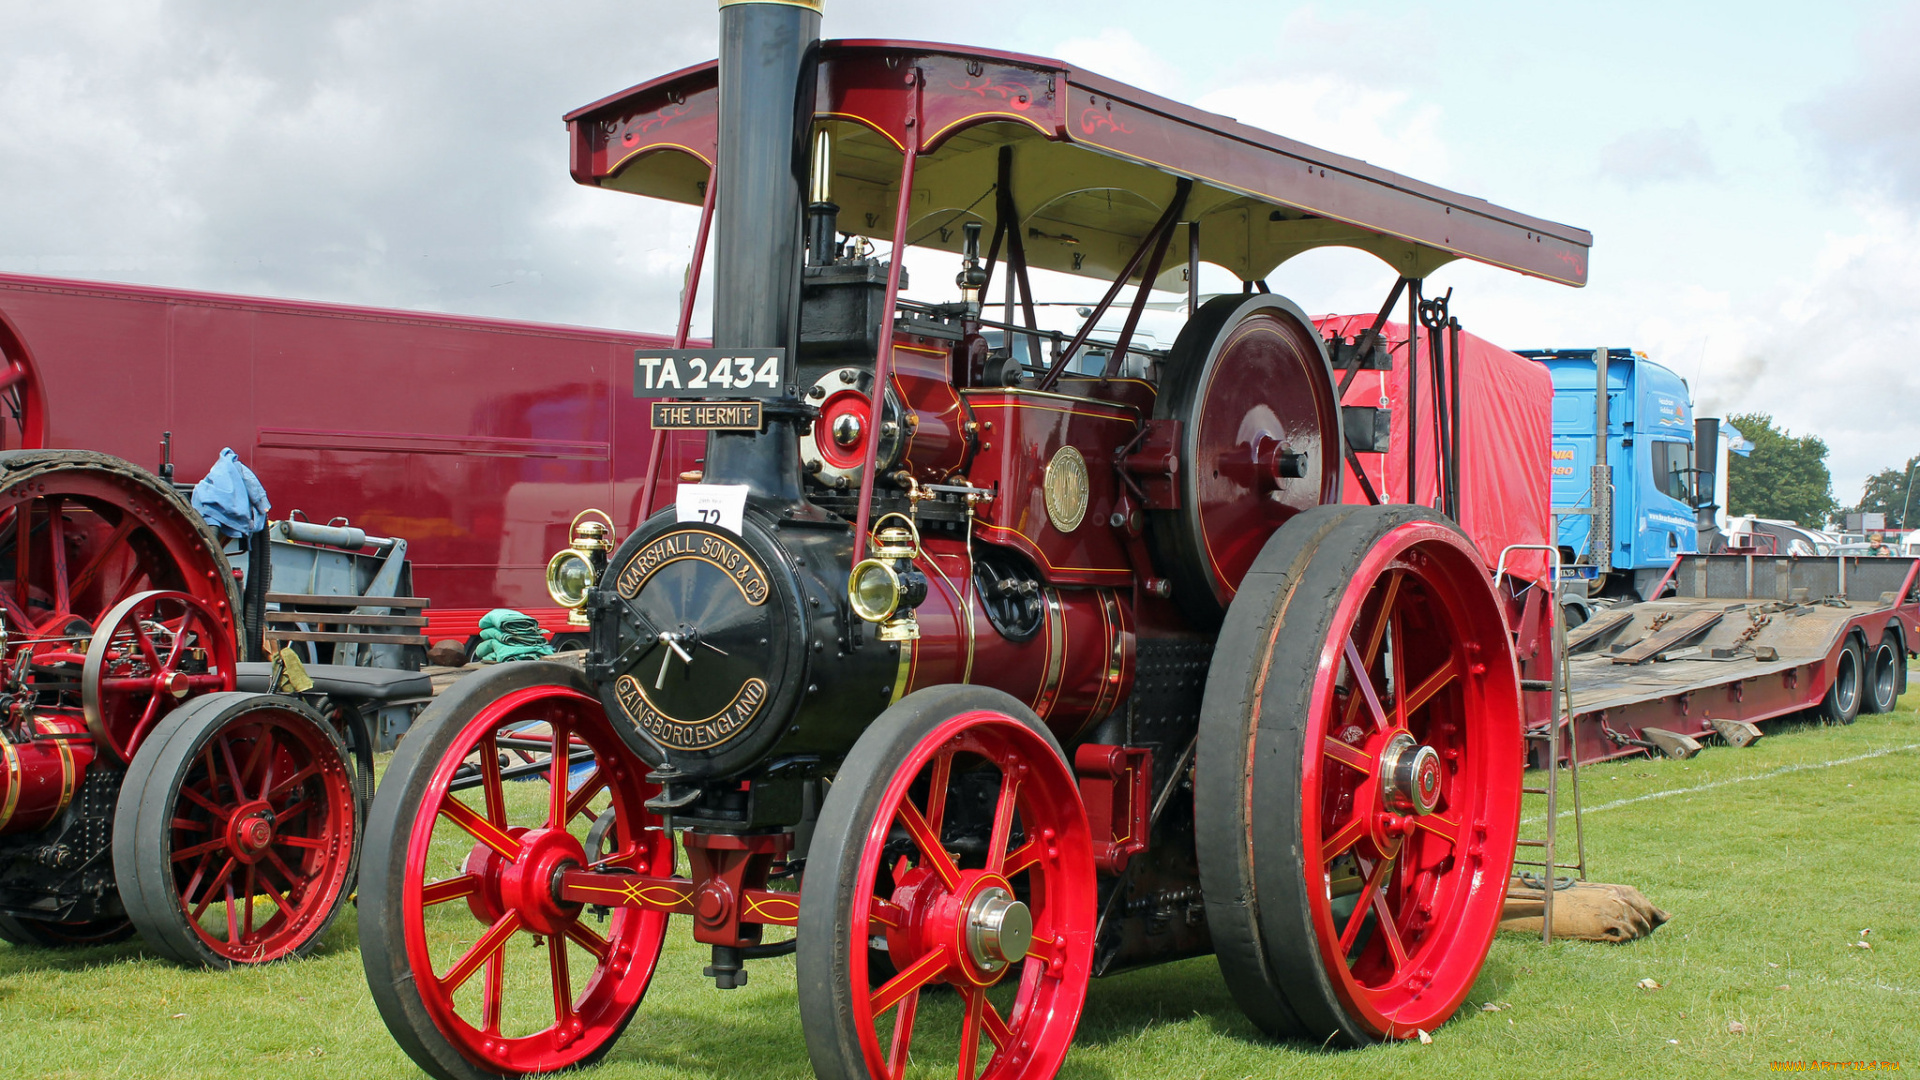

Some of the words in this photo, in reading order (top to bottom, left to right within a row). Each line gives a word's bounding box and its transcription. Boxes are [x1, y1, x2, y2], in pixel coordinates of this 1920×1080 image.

[638, 358, 682, 389] TA
[687, 357, 779, 388] 2434
[661, 407, 691, 424] THE
[696, 407, 751, 424] HERMIT
[620, 536, 696, 595] MARSHALL
[701, 537, 740, 570] SONS
[736, 564, 750, 581] &
[695, 682, 763, 745] ENGLAND
